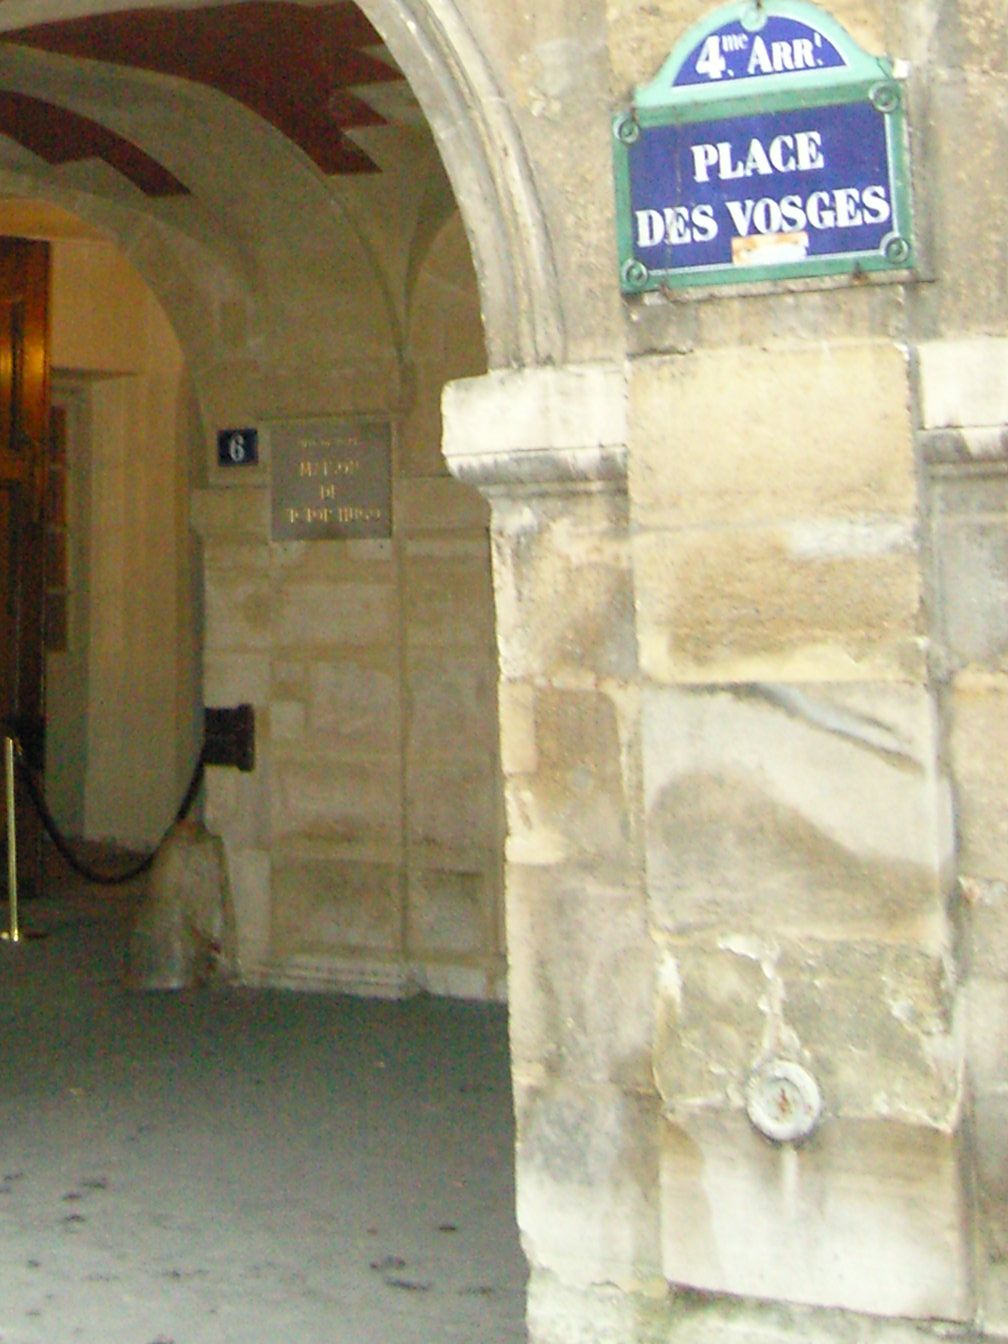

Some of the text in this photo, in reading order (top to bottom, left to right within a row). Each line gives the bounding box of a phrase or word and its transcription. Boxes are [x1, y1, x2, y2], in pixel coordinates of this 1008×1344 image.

[691, 131, 824, 182] PLACE
[635, 185, 890, 248] DES VOSGES
[229, 432, 245, 462] 6
